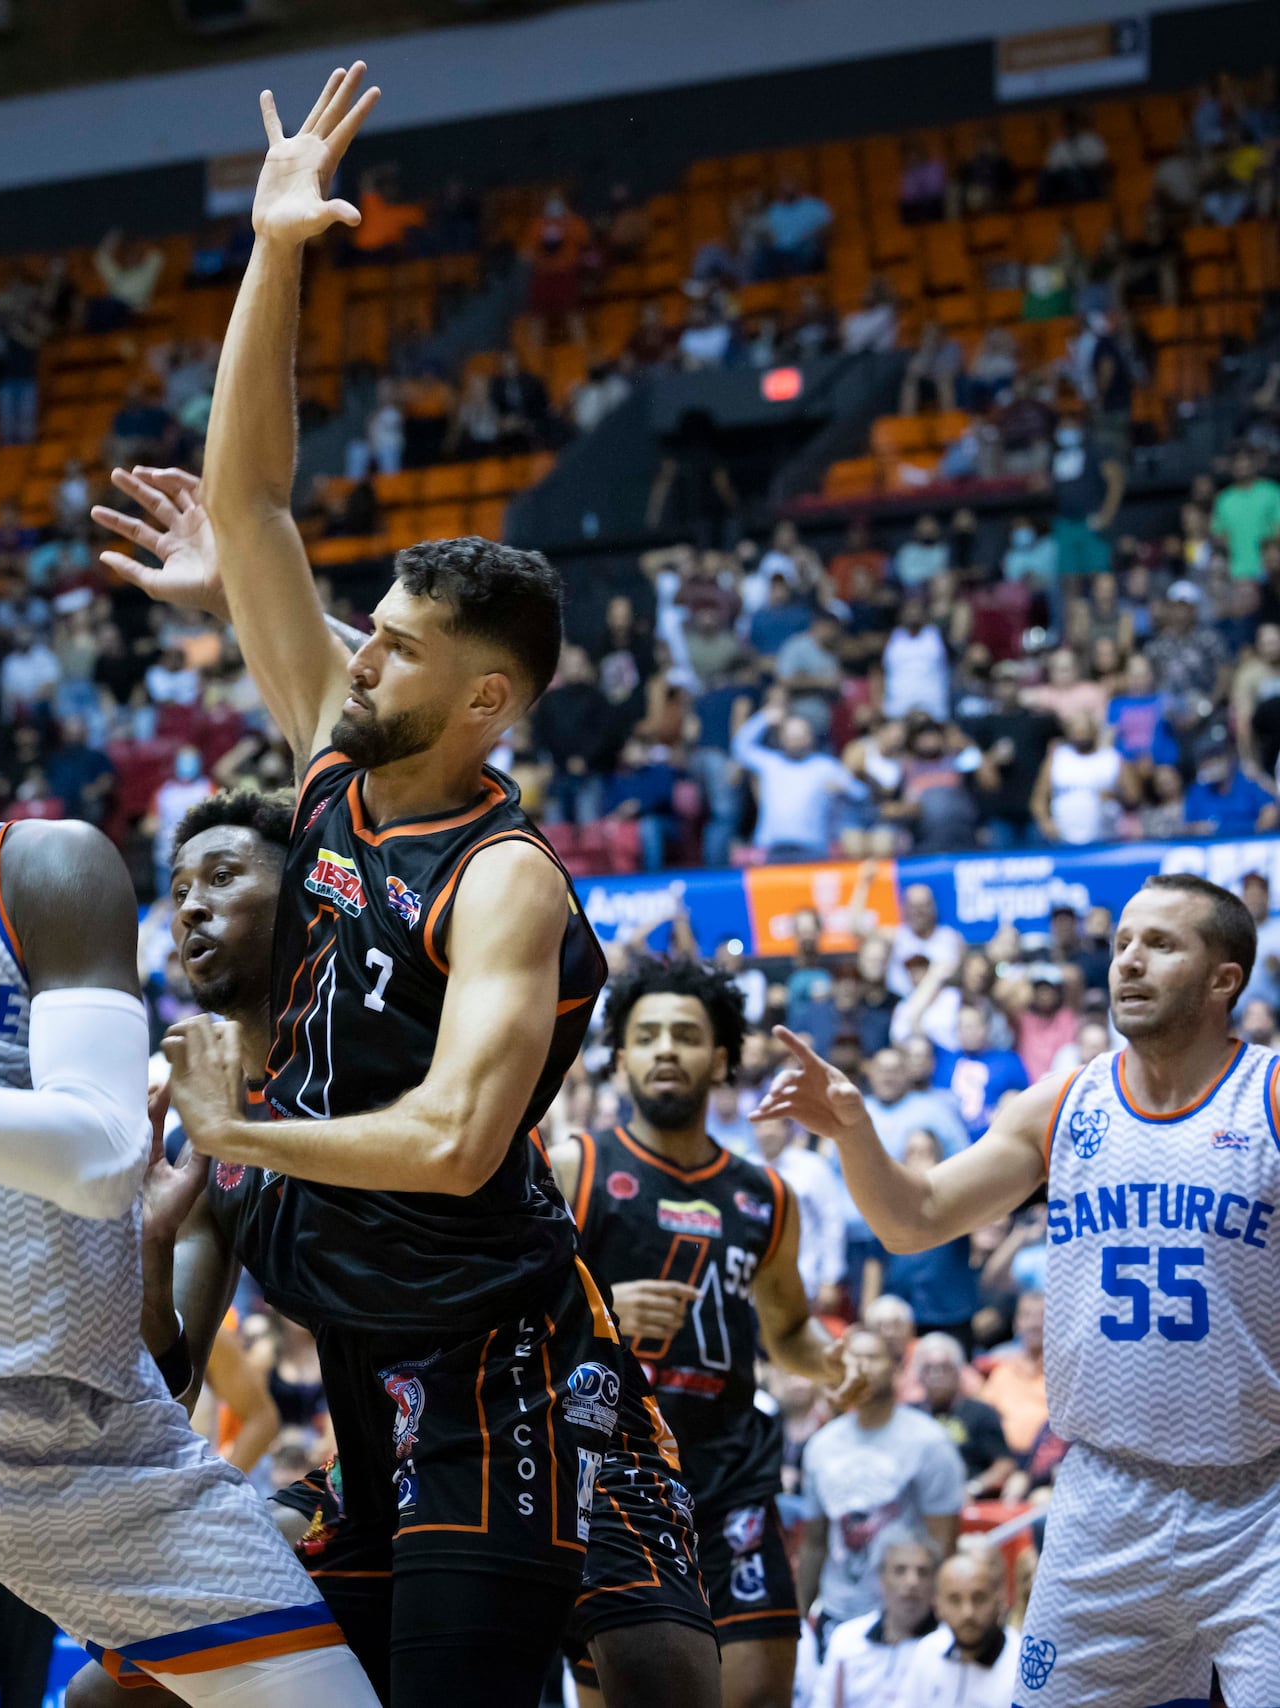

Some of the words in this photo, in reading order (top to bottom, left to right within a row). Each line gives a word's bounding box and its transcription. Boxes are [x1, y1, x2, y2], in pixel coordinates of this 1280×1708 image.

[364, 947, 394, 1013] 7
[1047, 1184, 1275, 1249] SANTURCE
[1099, 1247, 1210, 1342] 55
